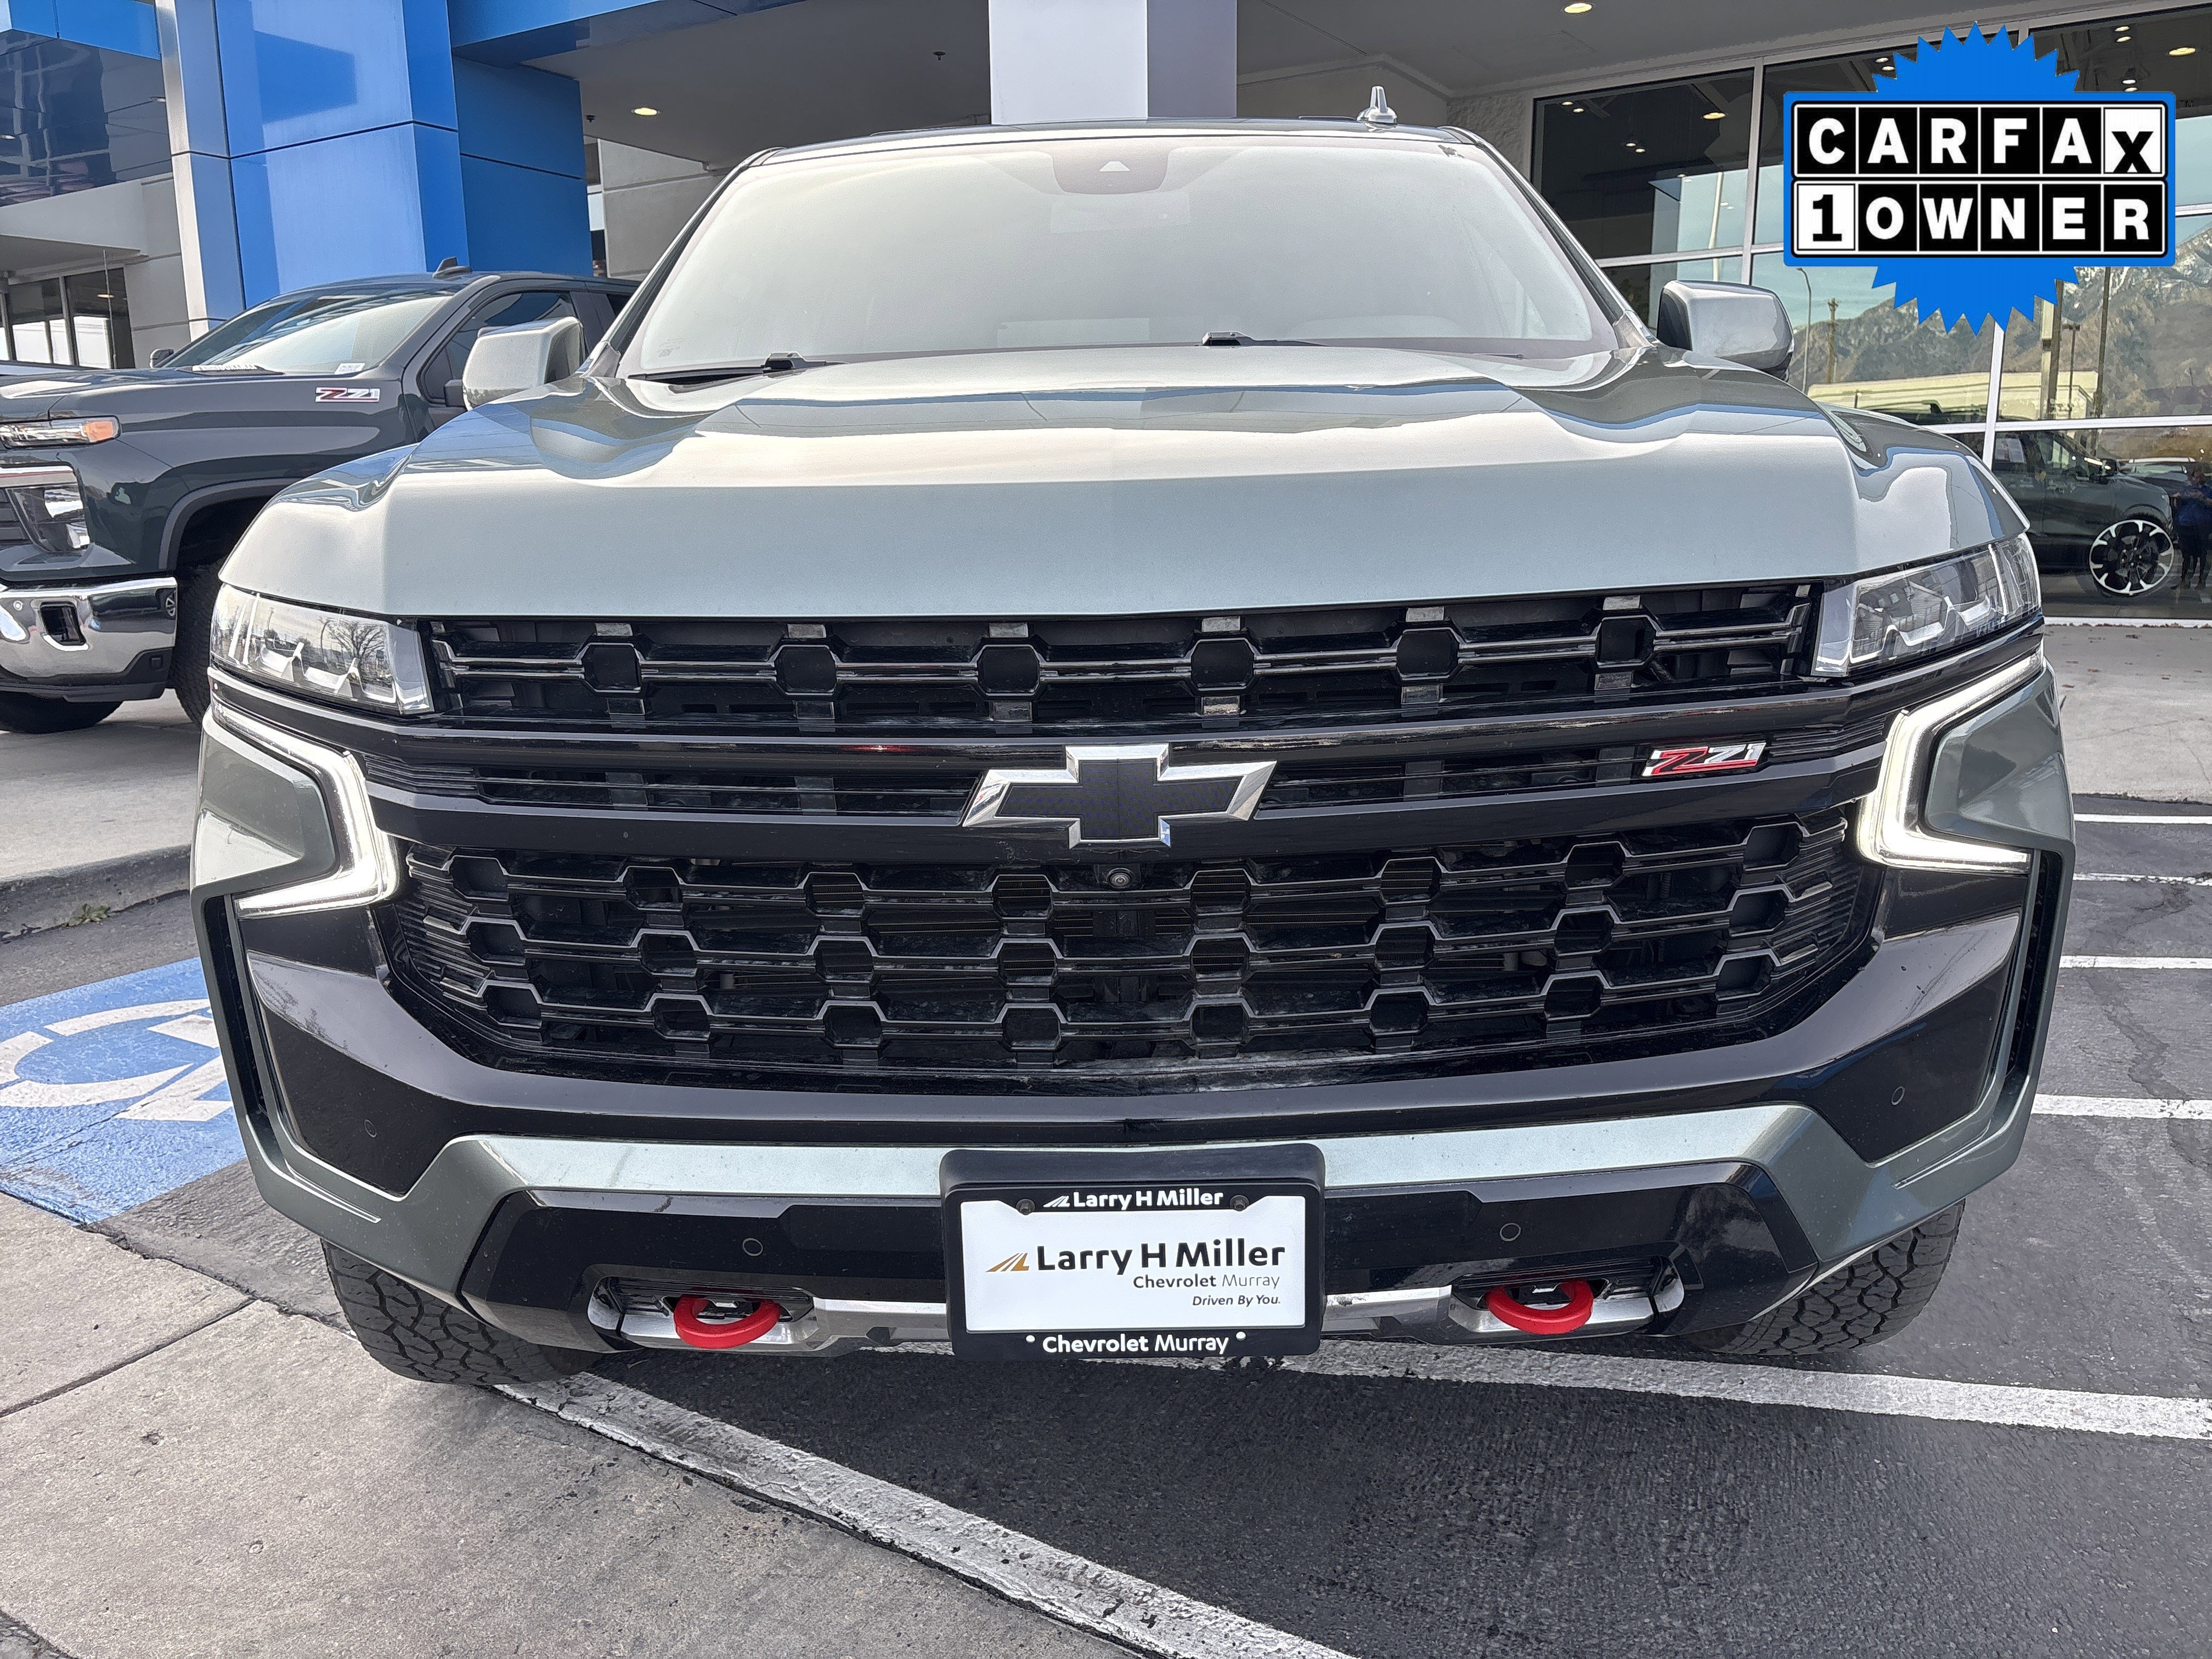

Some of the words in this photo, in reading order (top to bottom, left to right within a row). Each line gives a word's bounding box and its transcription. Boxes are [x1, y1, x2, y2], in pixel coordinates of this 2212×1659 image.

[315, 387, 380, 403] Z71
[1642, 742, 1767, 776] Z71
[1073, 1192, 1132, 1211] Larry
[1136, 1190, 1152, 1206] H
[1156, 1188, 1223, 1206] Miller
[1037, 1246, 1133, 1276] Larry
[1141, 1243, 1166, 1268] H
[1176, 1238, 1285, 1267] Miller
[1133, 1273, 1217, 1289] Chevrolet
[1222, 1274, 1280, 1289] Murray
[1192, 1295, 1233, 1306] Driven
[1238, 1295, 1254, 1307] By
[1255, 1294, 1281, 1305] You.
[1042, 1333, 1149, 1353] Chevrolet
[1154, 1334, 1229, 1355] Murray
